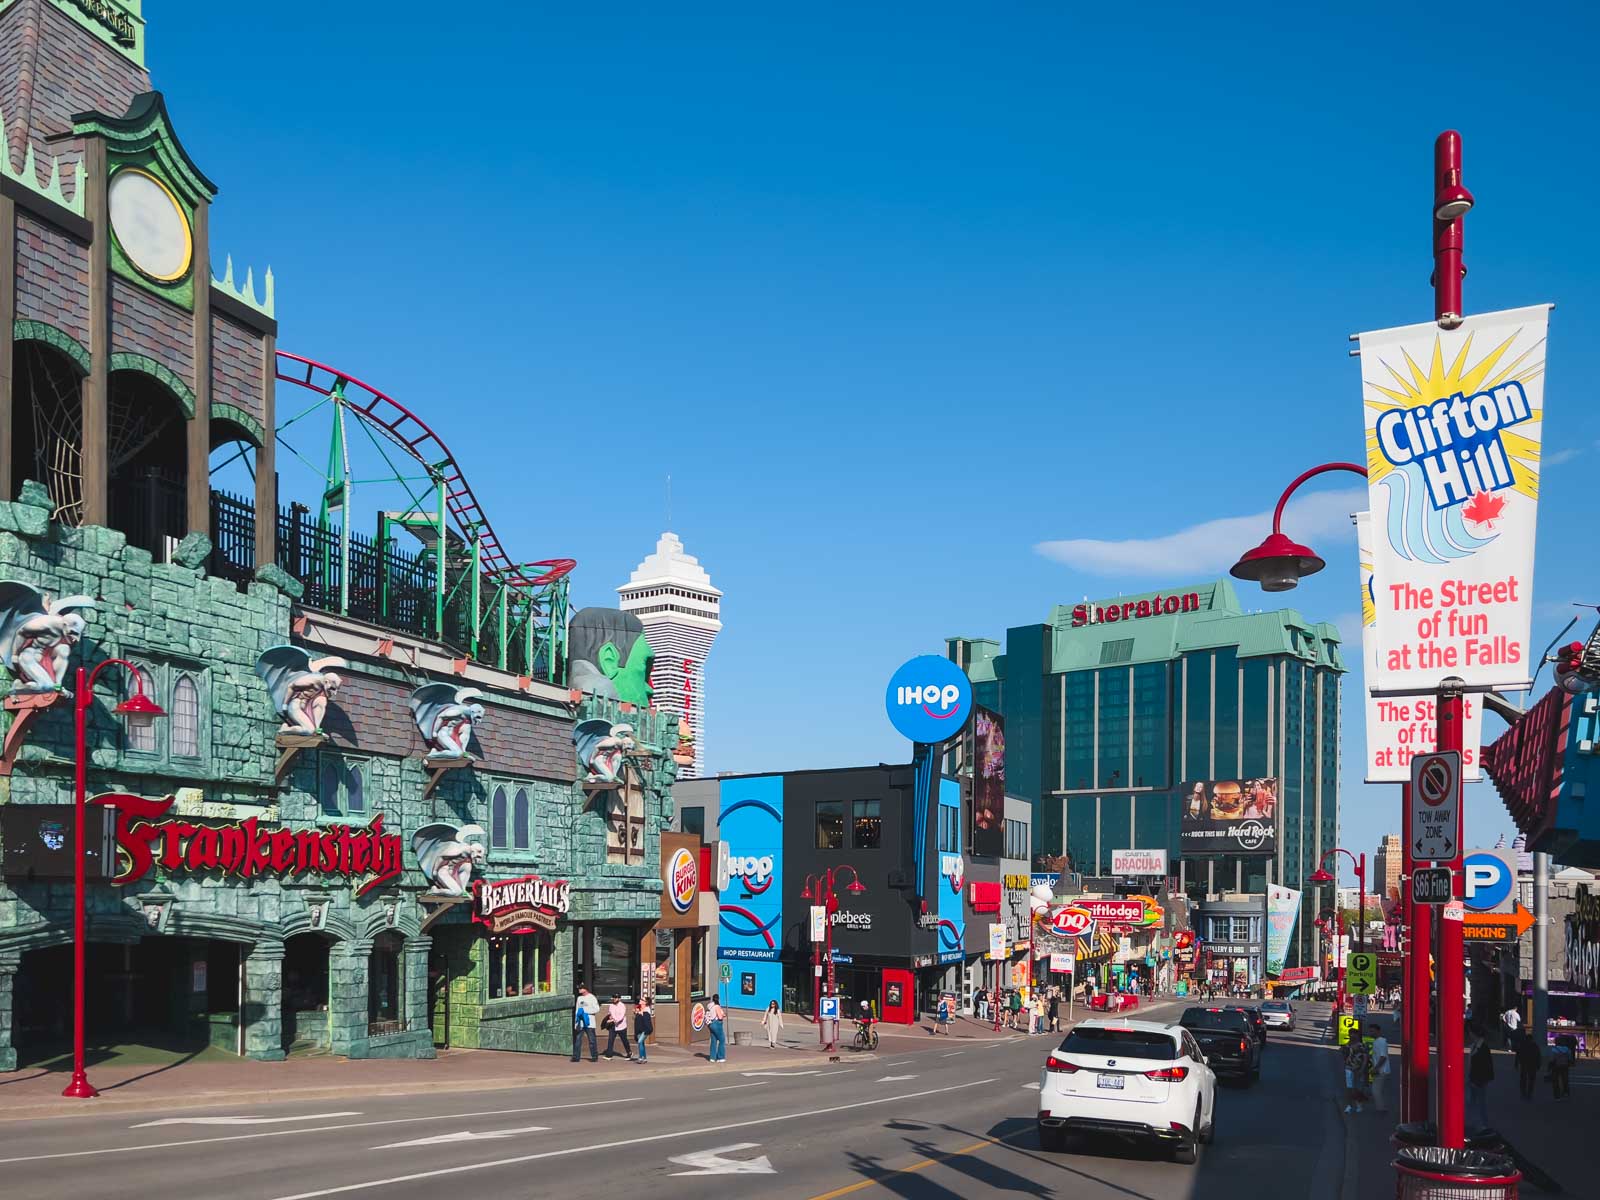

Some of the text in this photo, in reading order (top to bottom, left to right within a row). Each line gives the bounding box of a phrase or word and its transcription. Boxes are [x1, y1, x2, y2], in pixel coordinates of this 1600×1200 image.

[1378, 382, 1530, 464] Clifton
[1427, 438, 1511, 507] Hill
[1389, 576, 1518, 610] The Street
[1072, 592, 1200, 627] Sheraton
[1417, 608, 1488, 639] of fun
[1387, 635, 1521, 671] at the Falls
[898, 685, 960, 709] IHOP
[1377, 699, 1472, 721] The Stt
[1397, 722, 1437, 743] of fu
[1375, 747, 1392, 766] at
[1397, 745, 1425, 766] th
[1418, 810, 1451, 823] TOW AWAY
[1228, 825, 1274, 838] Hard Rock
[1425, 825, 1443, 839] ZONE
[86, 792, 402, 896] Frankenstein
[676, 861, 695, 882] BURGER
[729, 857, 772, 882] HOP
[1115, 857, 1162, 870] DRACULA
[676, 871, 696, 898] KING
[1031, 875, 1058, 886] avelo
[1415, 873, 1449, 897] $66 Fine
[1466, 864, 1500, 898] P
[515, 911, 533, 921] FAMOUS
[534, 912, 552, 925] PASTRIES
[825, 910, 871, 926] plebee's
[1059, 912, 1085, 930] DQ
[1088, 904, 1139, 919] iftlodge
[738, 950, 775, 958] RESTAURANT
[823, 1000, 835, 1014] P
